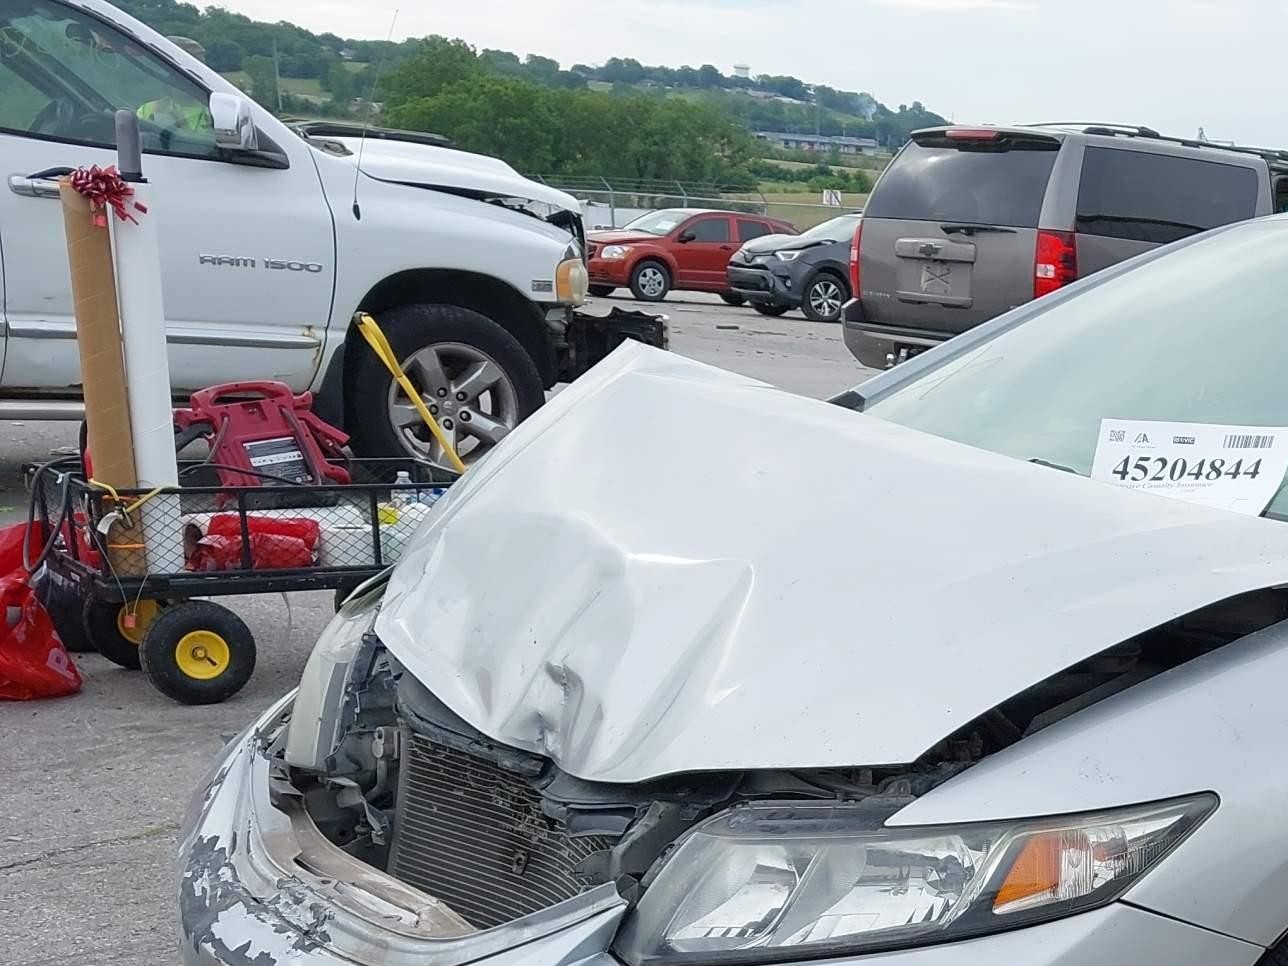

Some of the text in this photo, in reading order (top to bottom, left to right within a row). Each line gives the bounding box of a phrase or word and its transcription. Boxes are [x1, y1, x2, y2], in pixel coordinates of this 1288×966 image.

[199, 254, 323, 273] RAM 1500
[1112, 454, 1262, 482] 45204844
